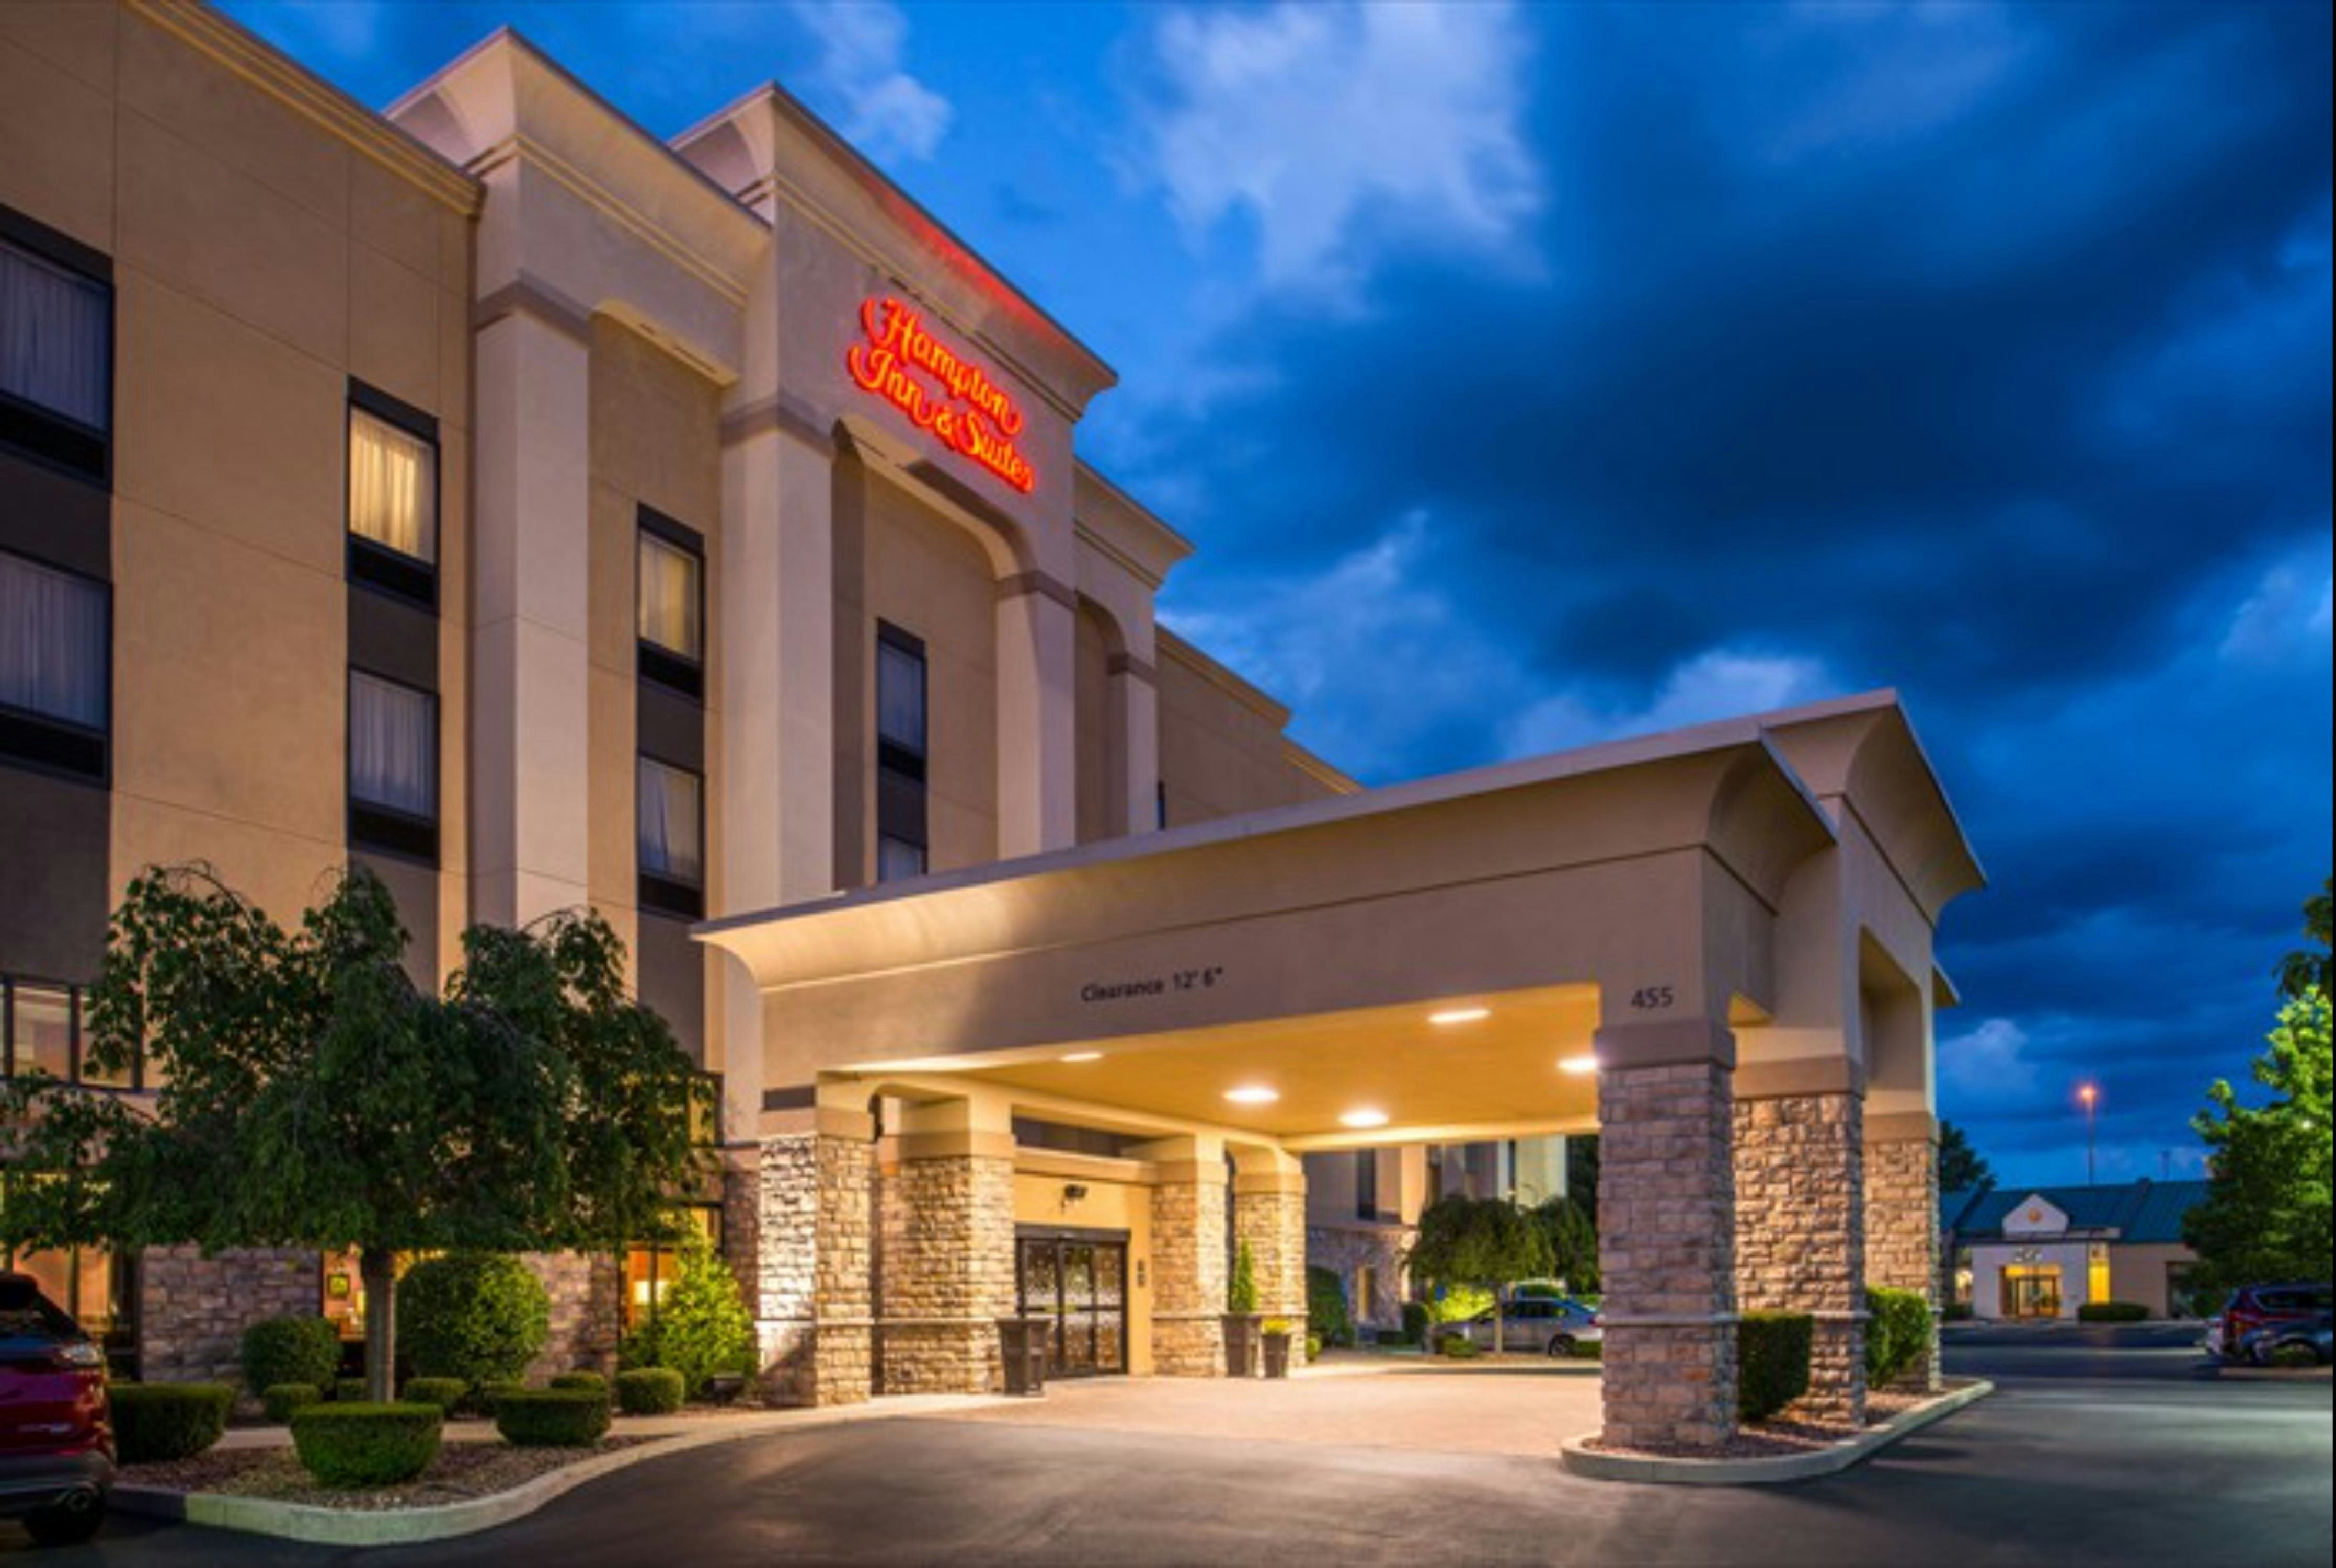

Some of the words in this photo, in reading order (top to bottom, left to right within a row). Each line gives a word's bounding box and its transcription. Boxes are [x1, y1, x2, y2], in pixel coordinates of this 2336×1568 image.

[861, 297, 1023, 436] Hampton
[848, 345, 935, 428] Inn
[935, 402, 958, 449] &
[955, 410, 1035, 493] Suites
[1081, 979, 1165, 1002] Clearance
[1631, 986, 1674, 1009] 455
